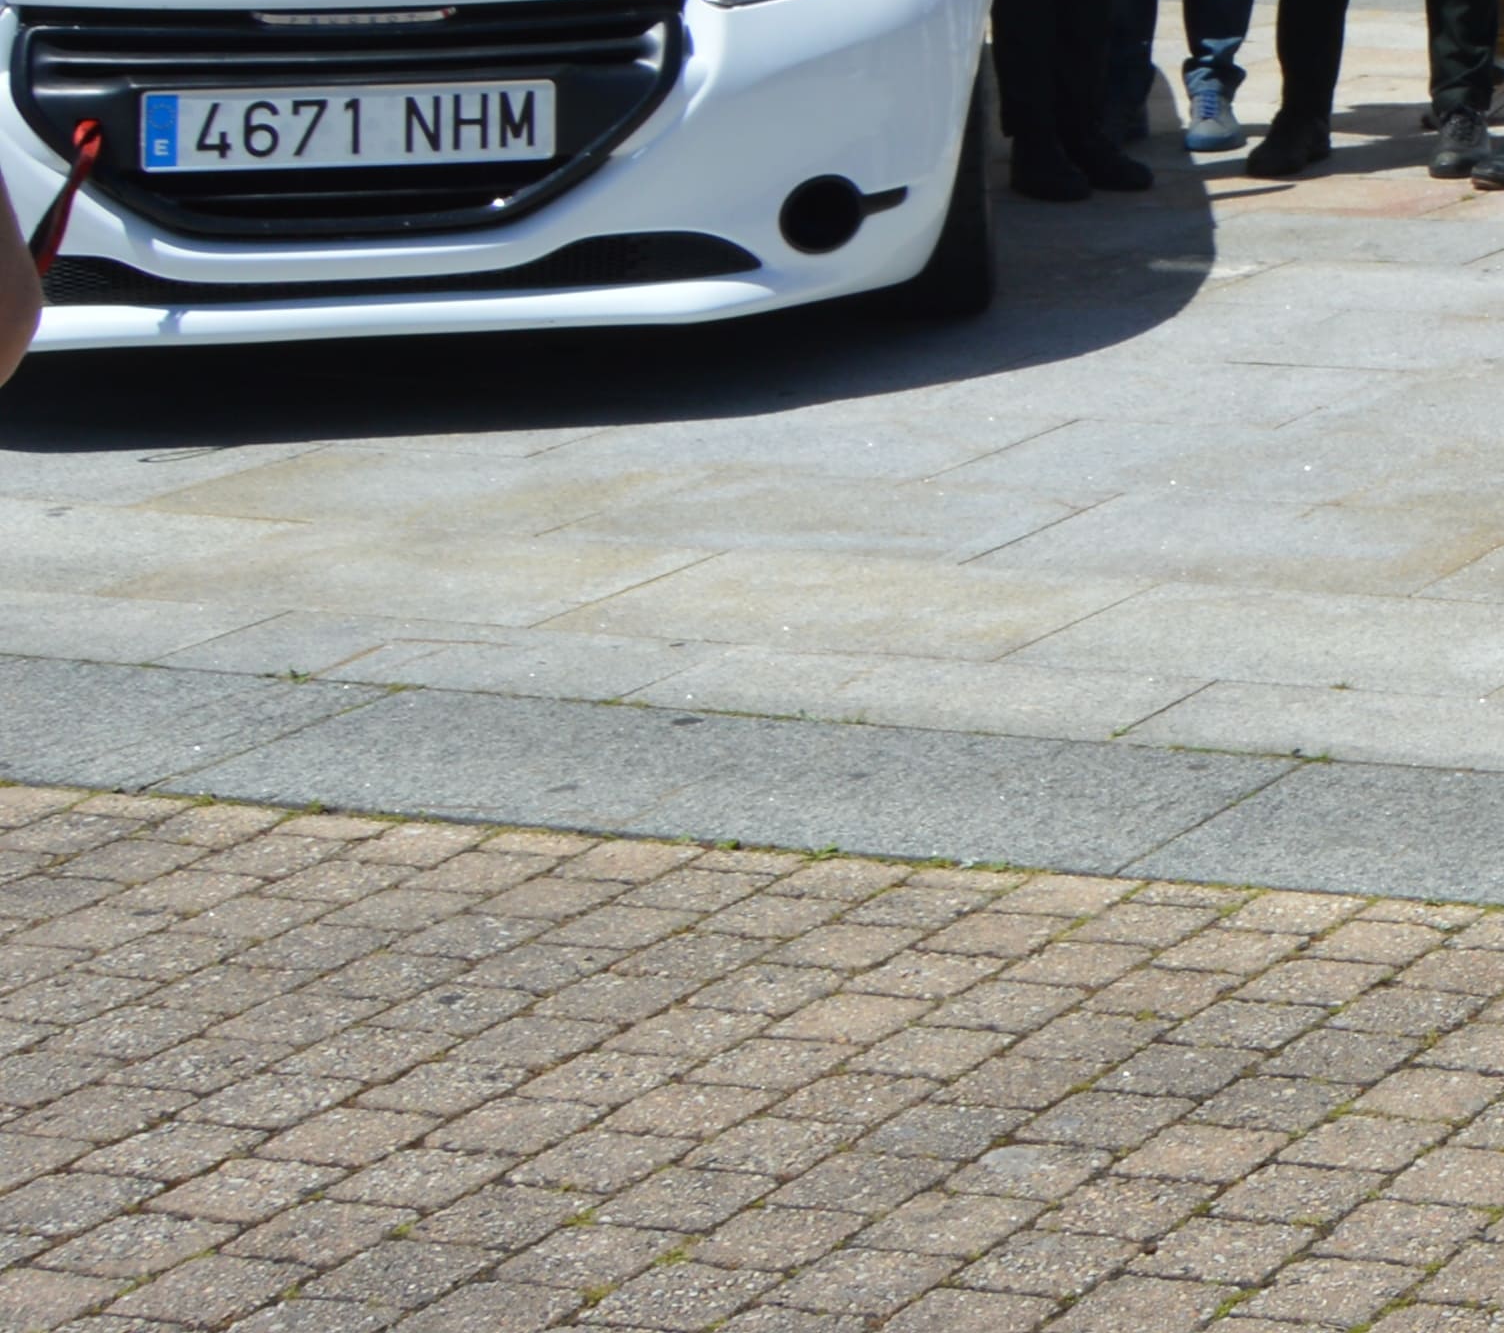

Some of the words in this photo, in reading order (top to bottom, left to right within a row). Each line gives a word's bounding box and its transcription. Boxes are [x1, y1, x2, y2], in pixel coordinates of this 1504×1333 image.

[153, 139, 169, 156] E
[195, 97, 361, 160] 4671
[404, 90, 536, 153] NHM
